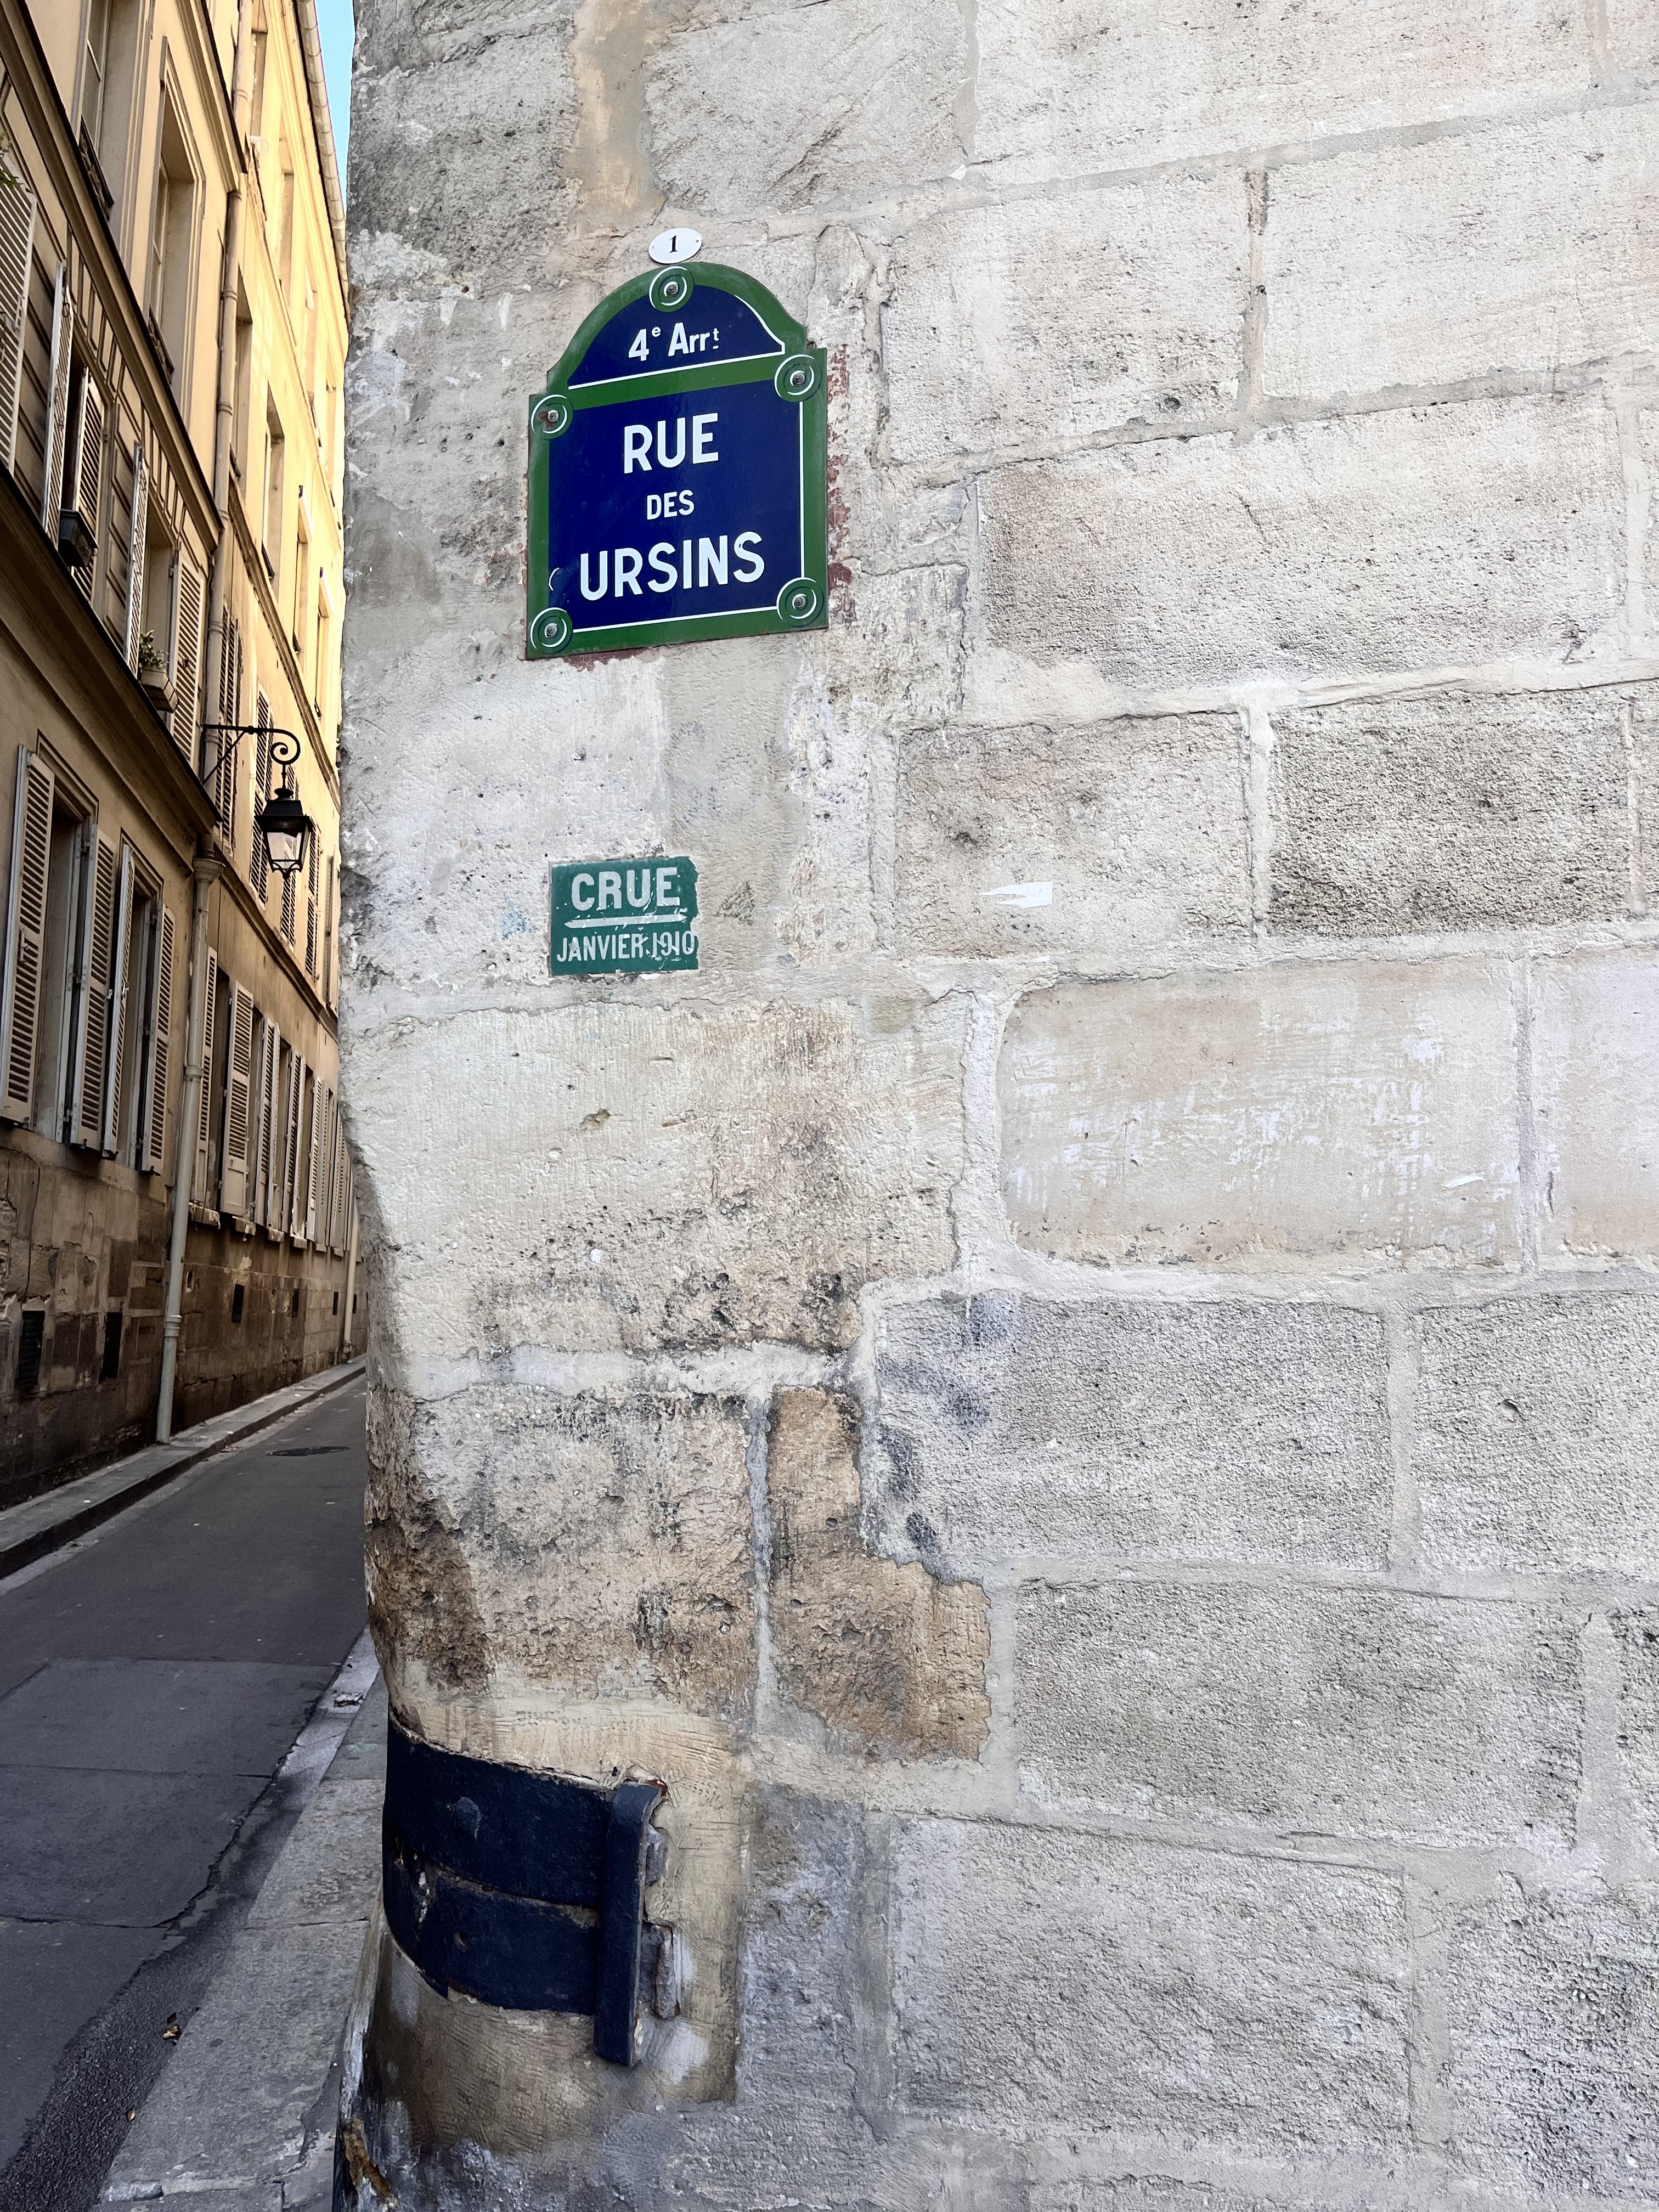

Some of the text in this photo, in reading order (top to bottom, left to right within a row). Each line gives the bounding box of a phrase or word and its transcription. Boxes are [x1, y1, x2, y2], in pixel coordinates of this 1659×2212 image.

[669, 235, 678, 253] 1
[628, 326, 662, 362] 4e
[623, 412, 720, 474] RUE
[646, 489, 695, 521] DES
[579, 531, 766, 601] URSINS
[571, 867, 681, 912] CRUE
[652, 930, 696, 957] 1910
